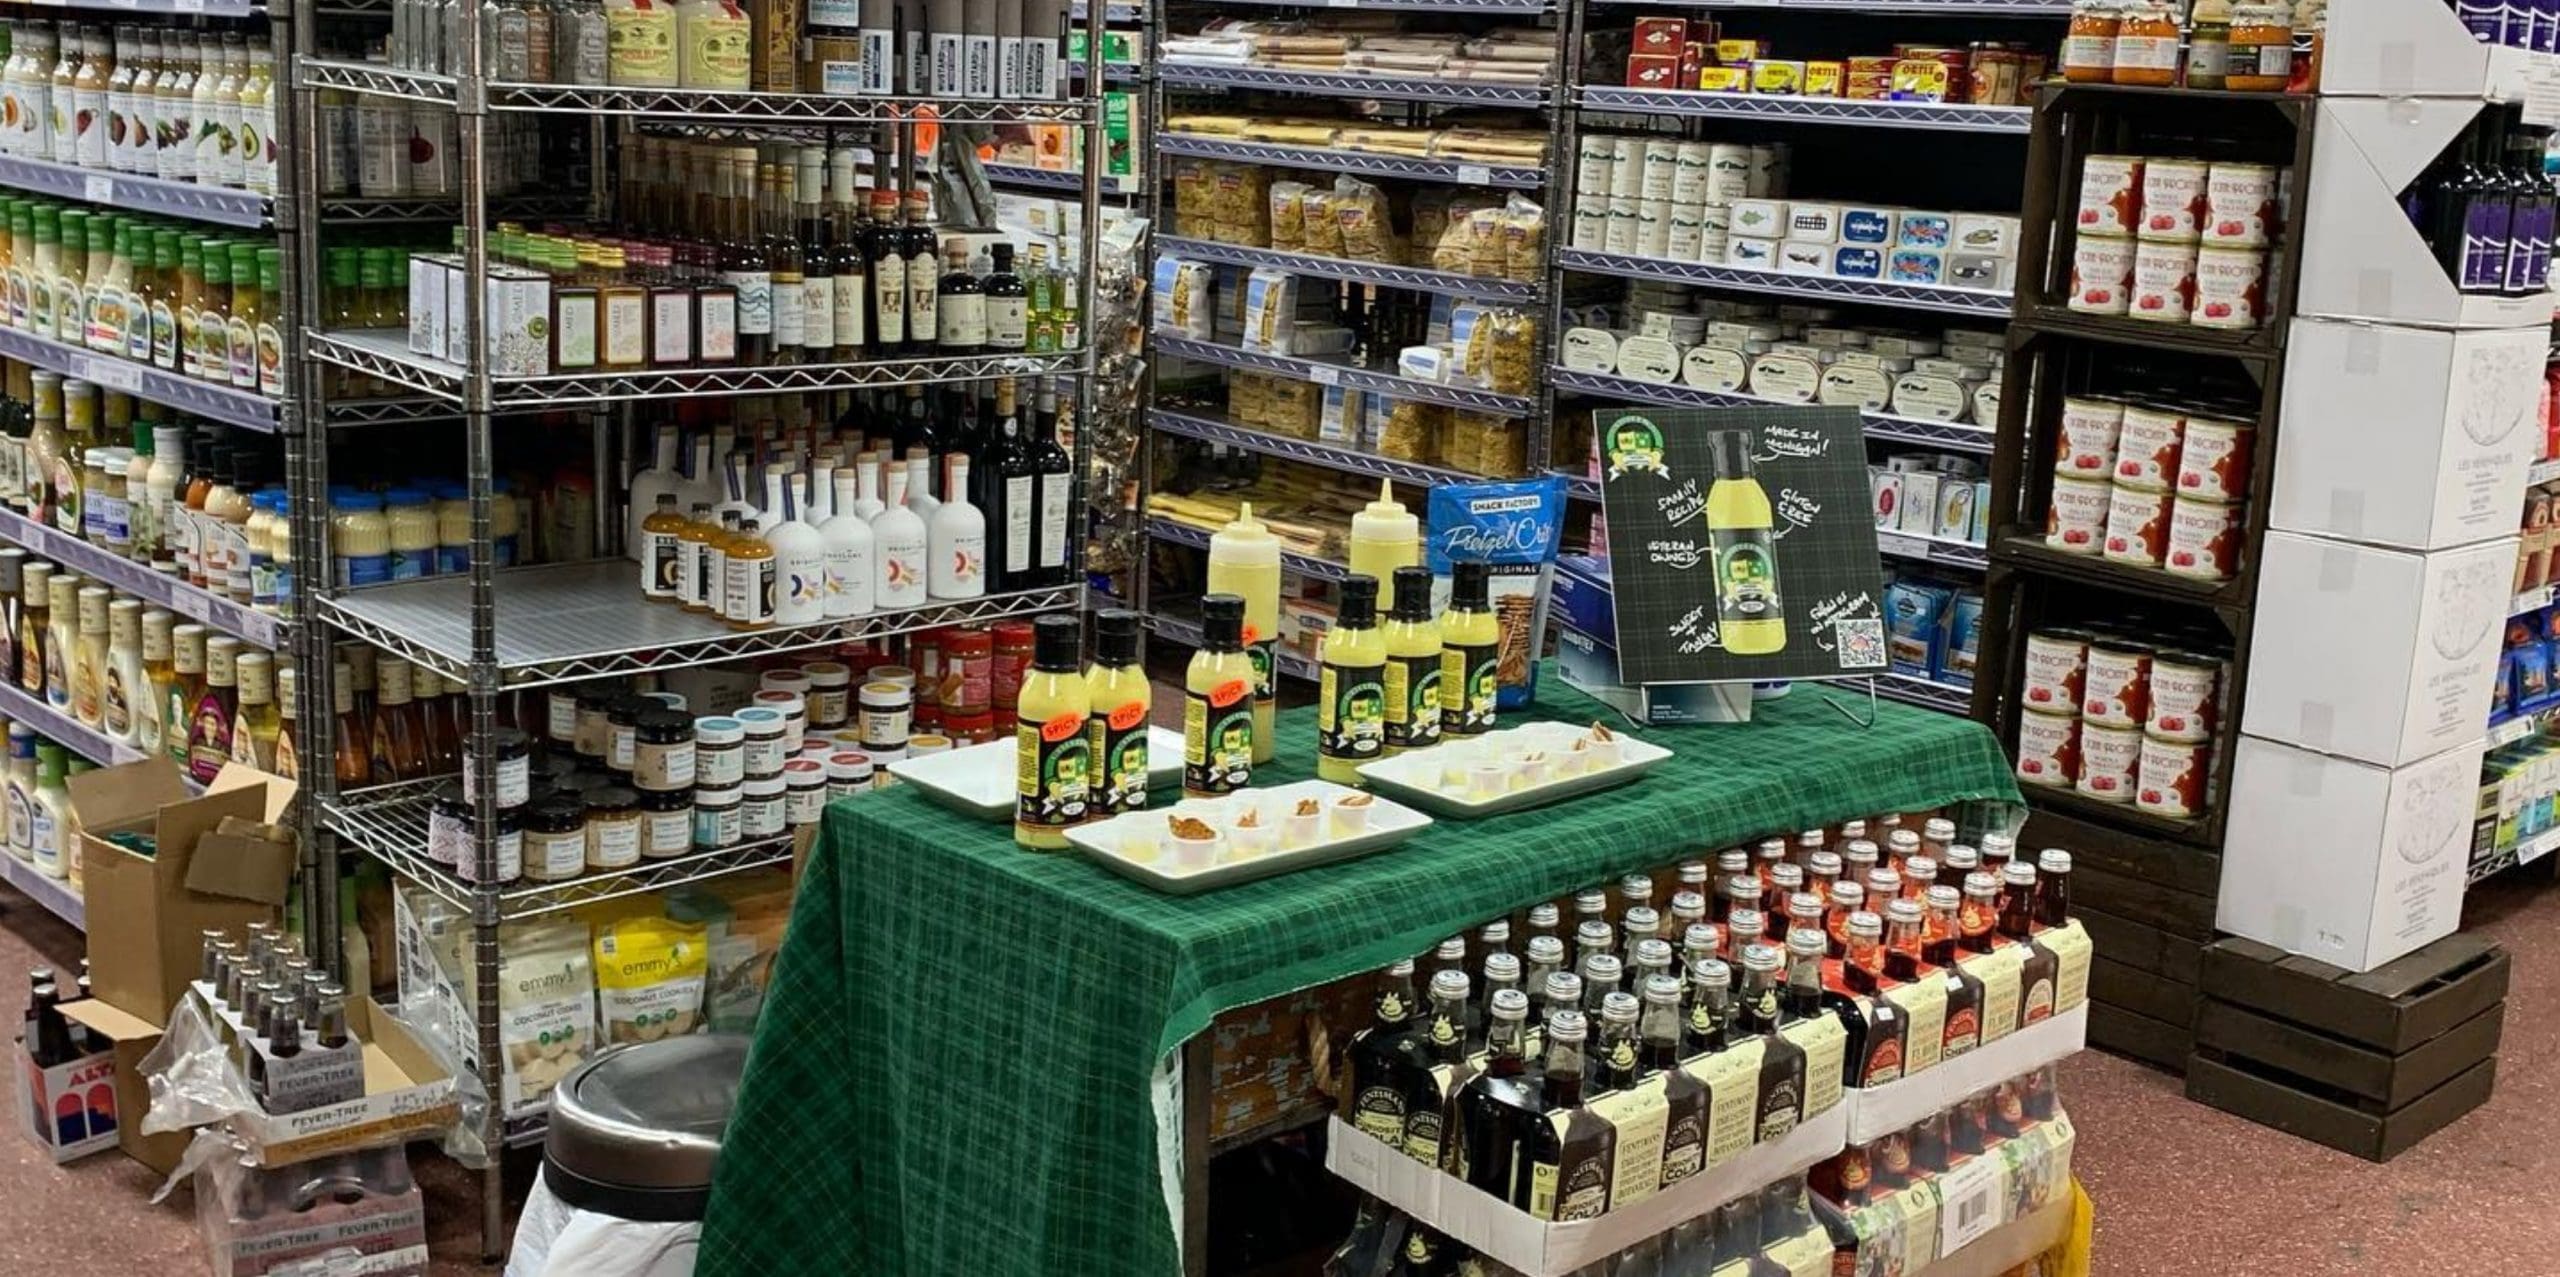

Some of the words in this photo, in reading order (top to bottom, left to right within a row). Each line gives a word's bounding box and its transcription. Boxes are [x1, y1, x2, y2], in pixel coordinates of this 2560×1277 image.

[1764, 425, 1799, 438] MADE
[1801, 430, 1820, 440] IN
[1474, 501, 1503, 511] SNACK
[1444, 521, 1516, 560] Pretzel
[1650, 551, 1696, 562] OWNED
[1489, 564, 1537, 573] RIGINAL
[1045, 718, 1077, 737] SPICY
[278, 1068, 355, 1090] FEVER-TREE
[291, 1103, 370, 1128] FEVER-TREE
[1666, 1162, 1697, 1180] COLA
[338, 1214, 415, 1236] FEVER-TREE
